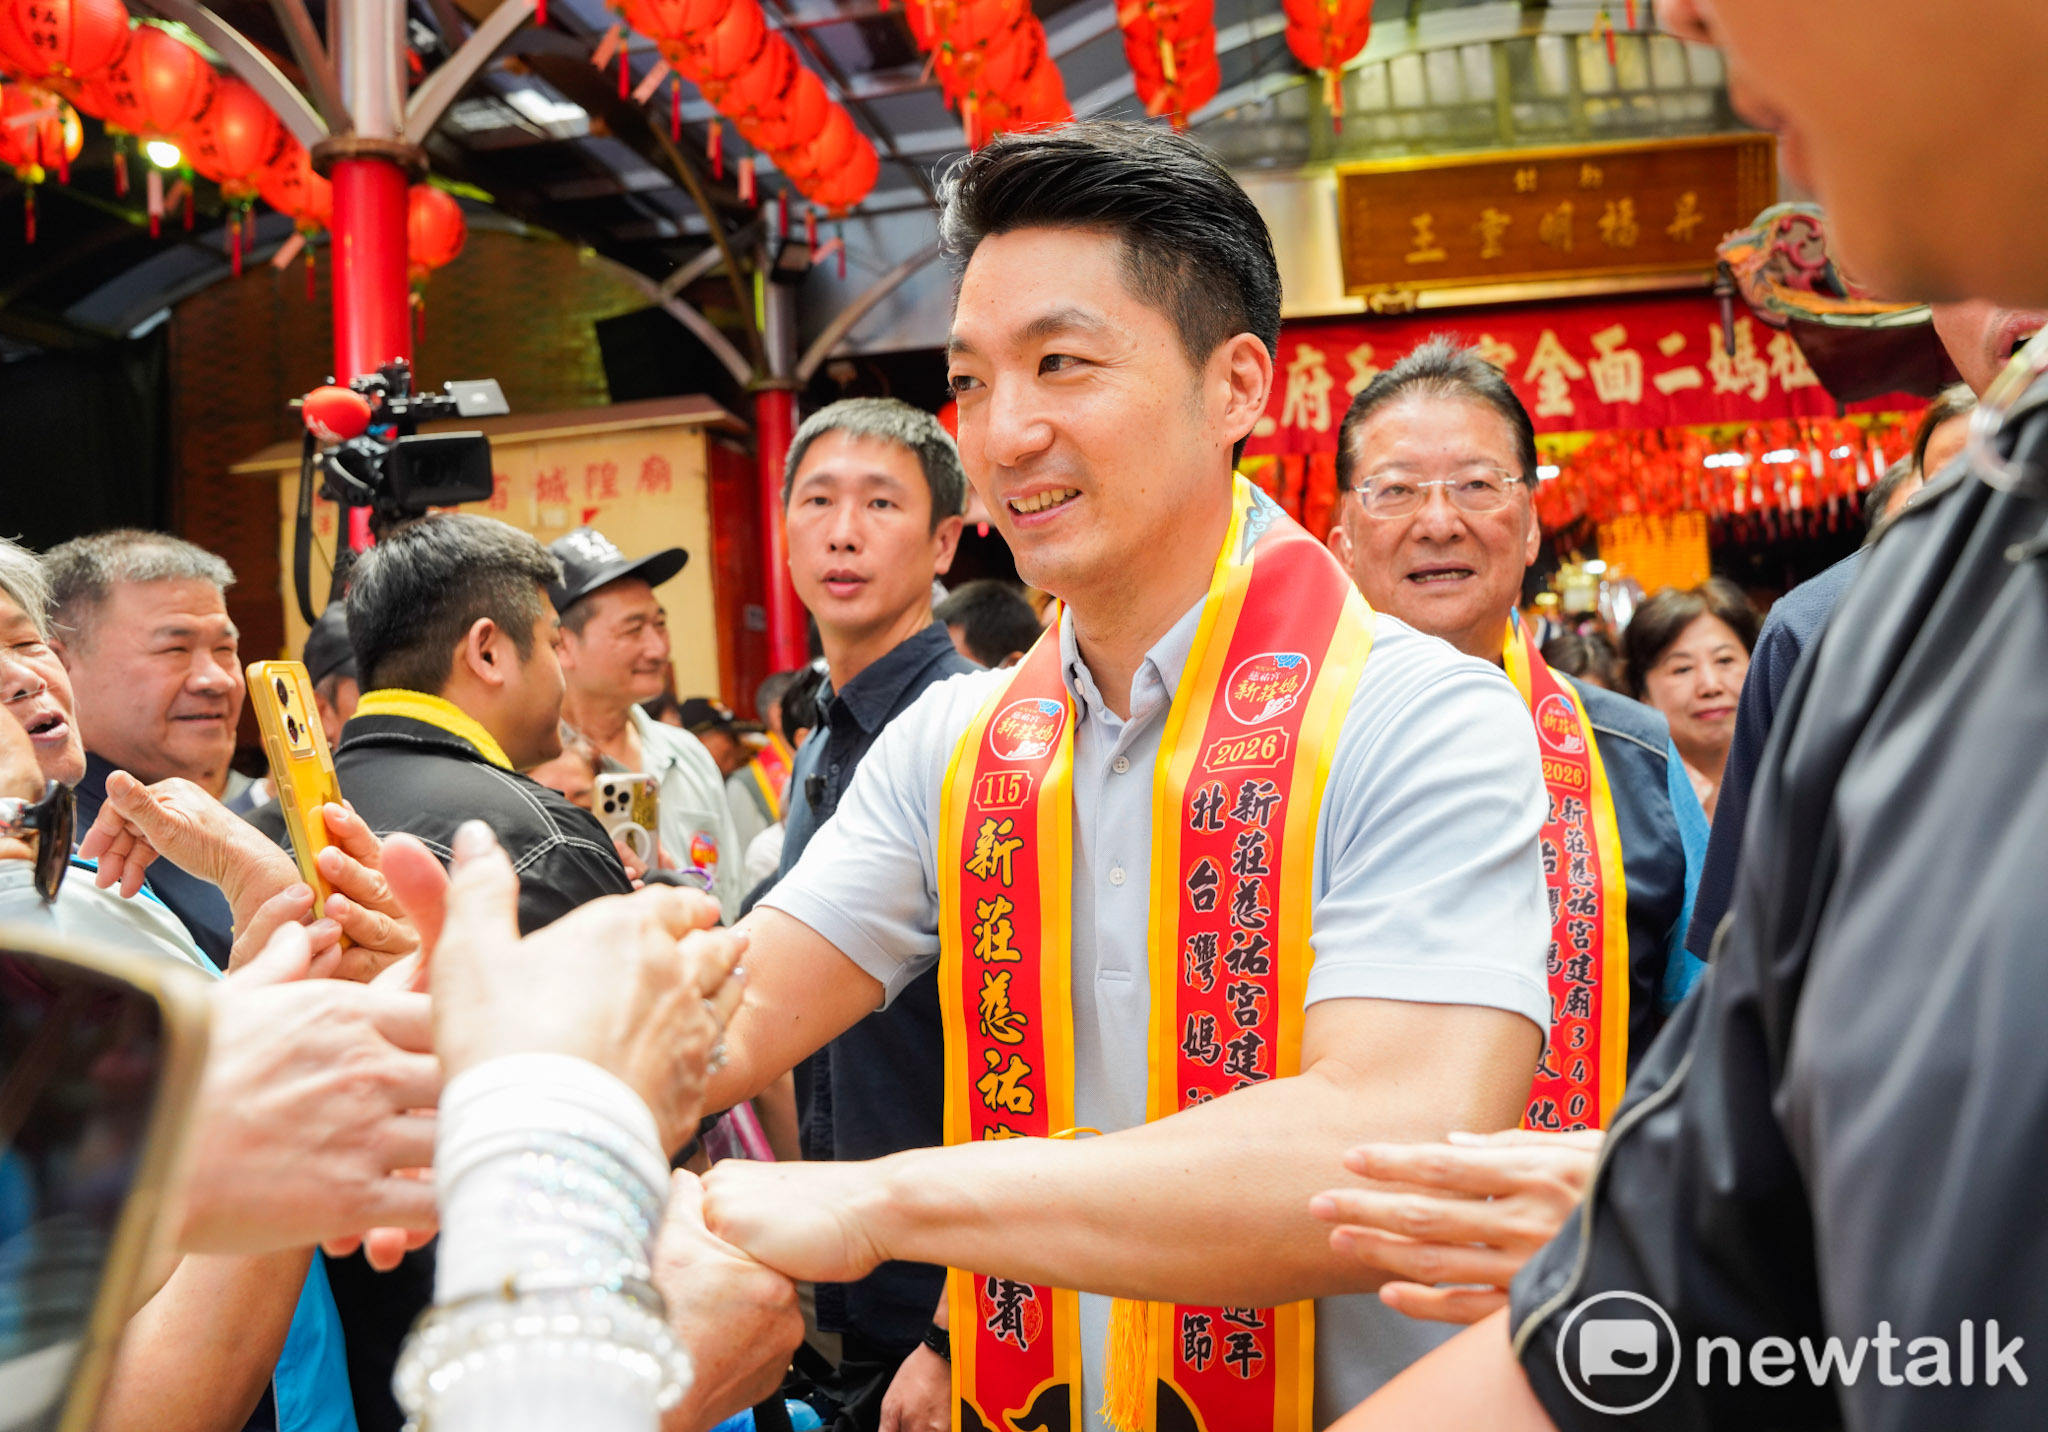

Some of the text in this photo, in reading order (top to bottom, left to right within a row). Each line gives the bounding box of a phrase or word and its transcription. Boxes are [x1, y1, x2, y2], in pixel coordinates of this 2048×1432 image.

[983, 774, 1021, 804] 115
[1213, 737, 1277, 767] 2026
[1543, 760, 1583, 787] 2026
[965, 817, 1037, 1140] 新莊慈祐
[1222, 779, 1282, 1091] 新莊慈祐宮建
[1560, 796, 1598, 1132] 新莊慈祐宮建廟340
